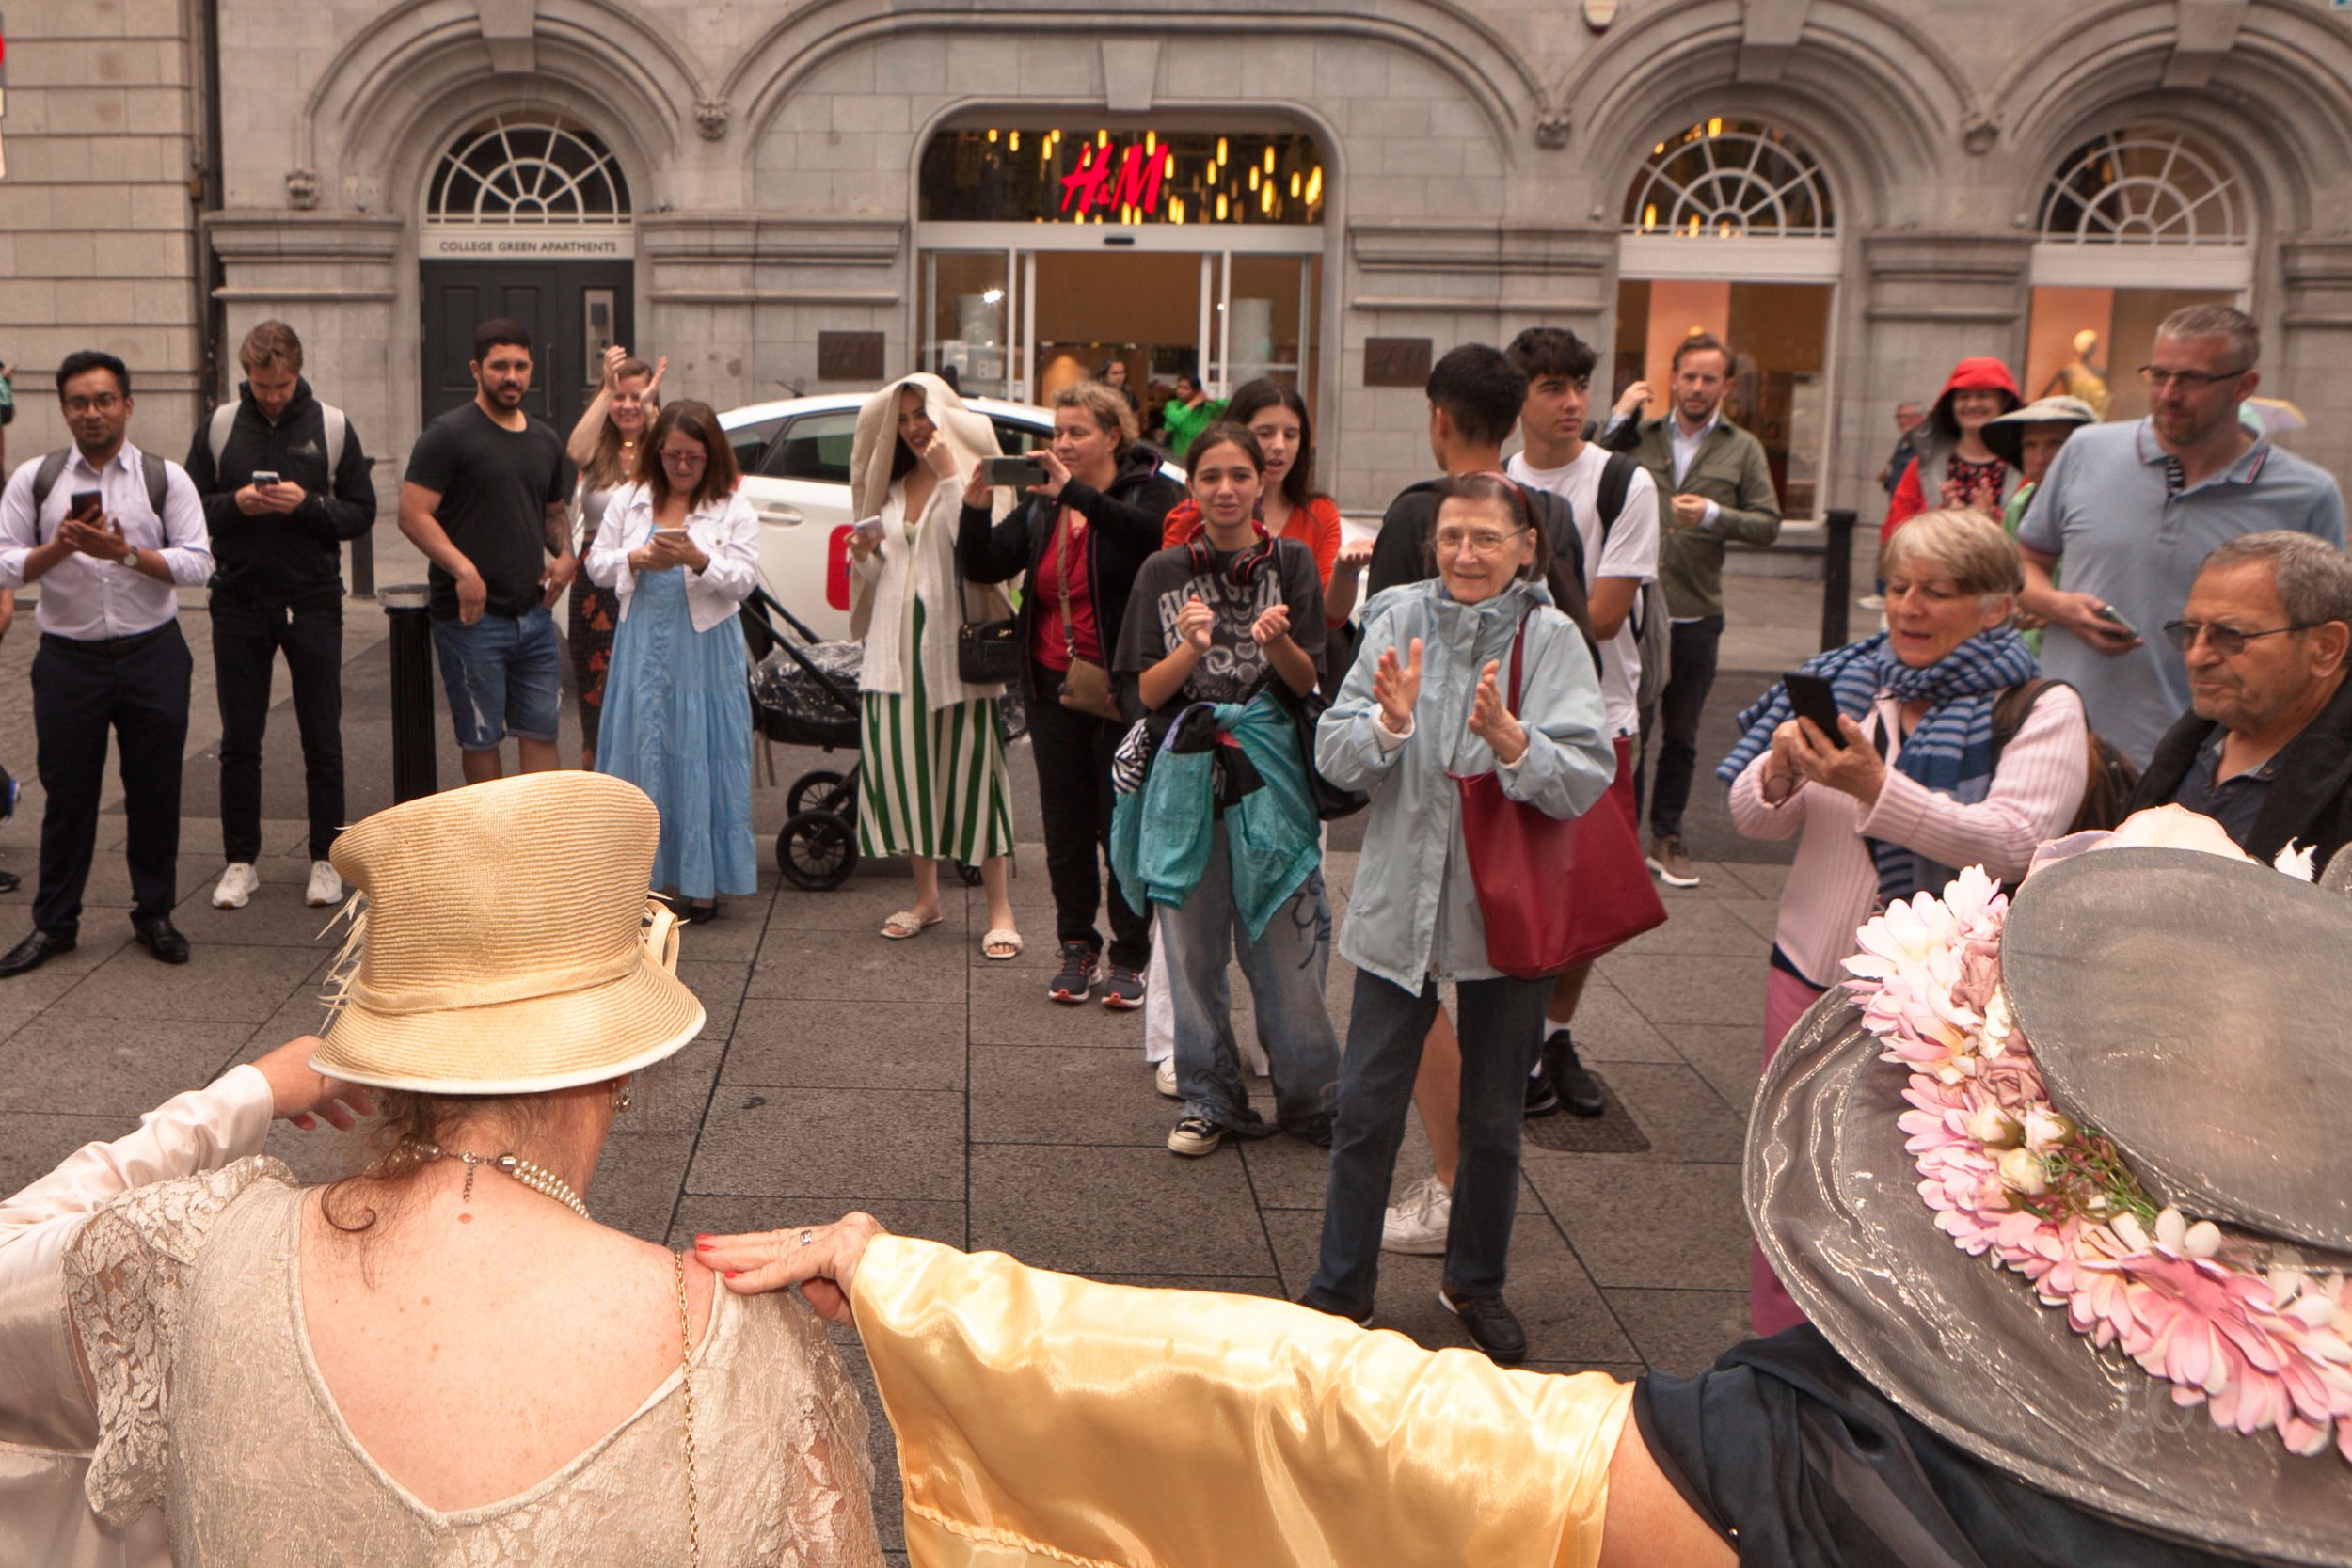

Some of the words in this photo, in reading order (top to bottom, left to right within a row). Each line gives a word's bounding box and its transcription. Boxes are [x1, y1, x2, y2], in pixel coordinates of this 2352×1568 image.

[1060, 143, 1169, 215] H&M
[439, 241, 493, 252] COLLEGE
[498, 241, 537, 252] GREEN
[540, 241, 617, 252] APARTMENTS
